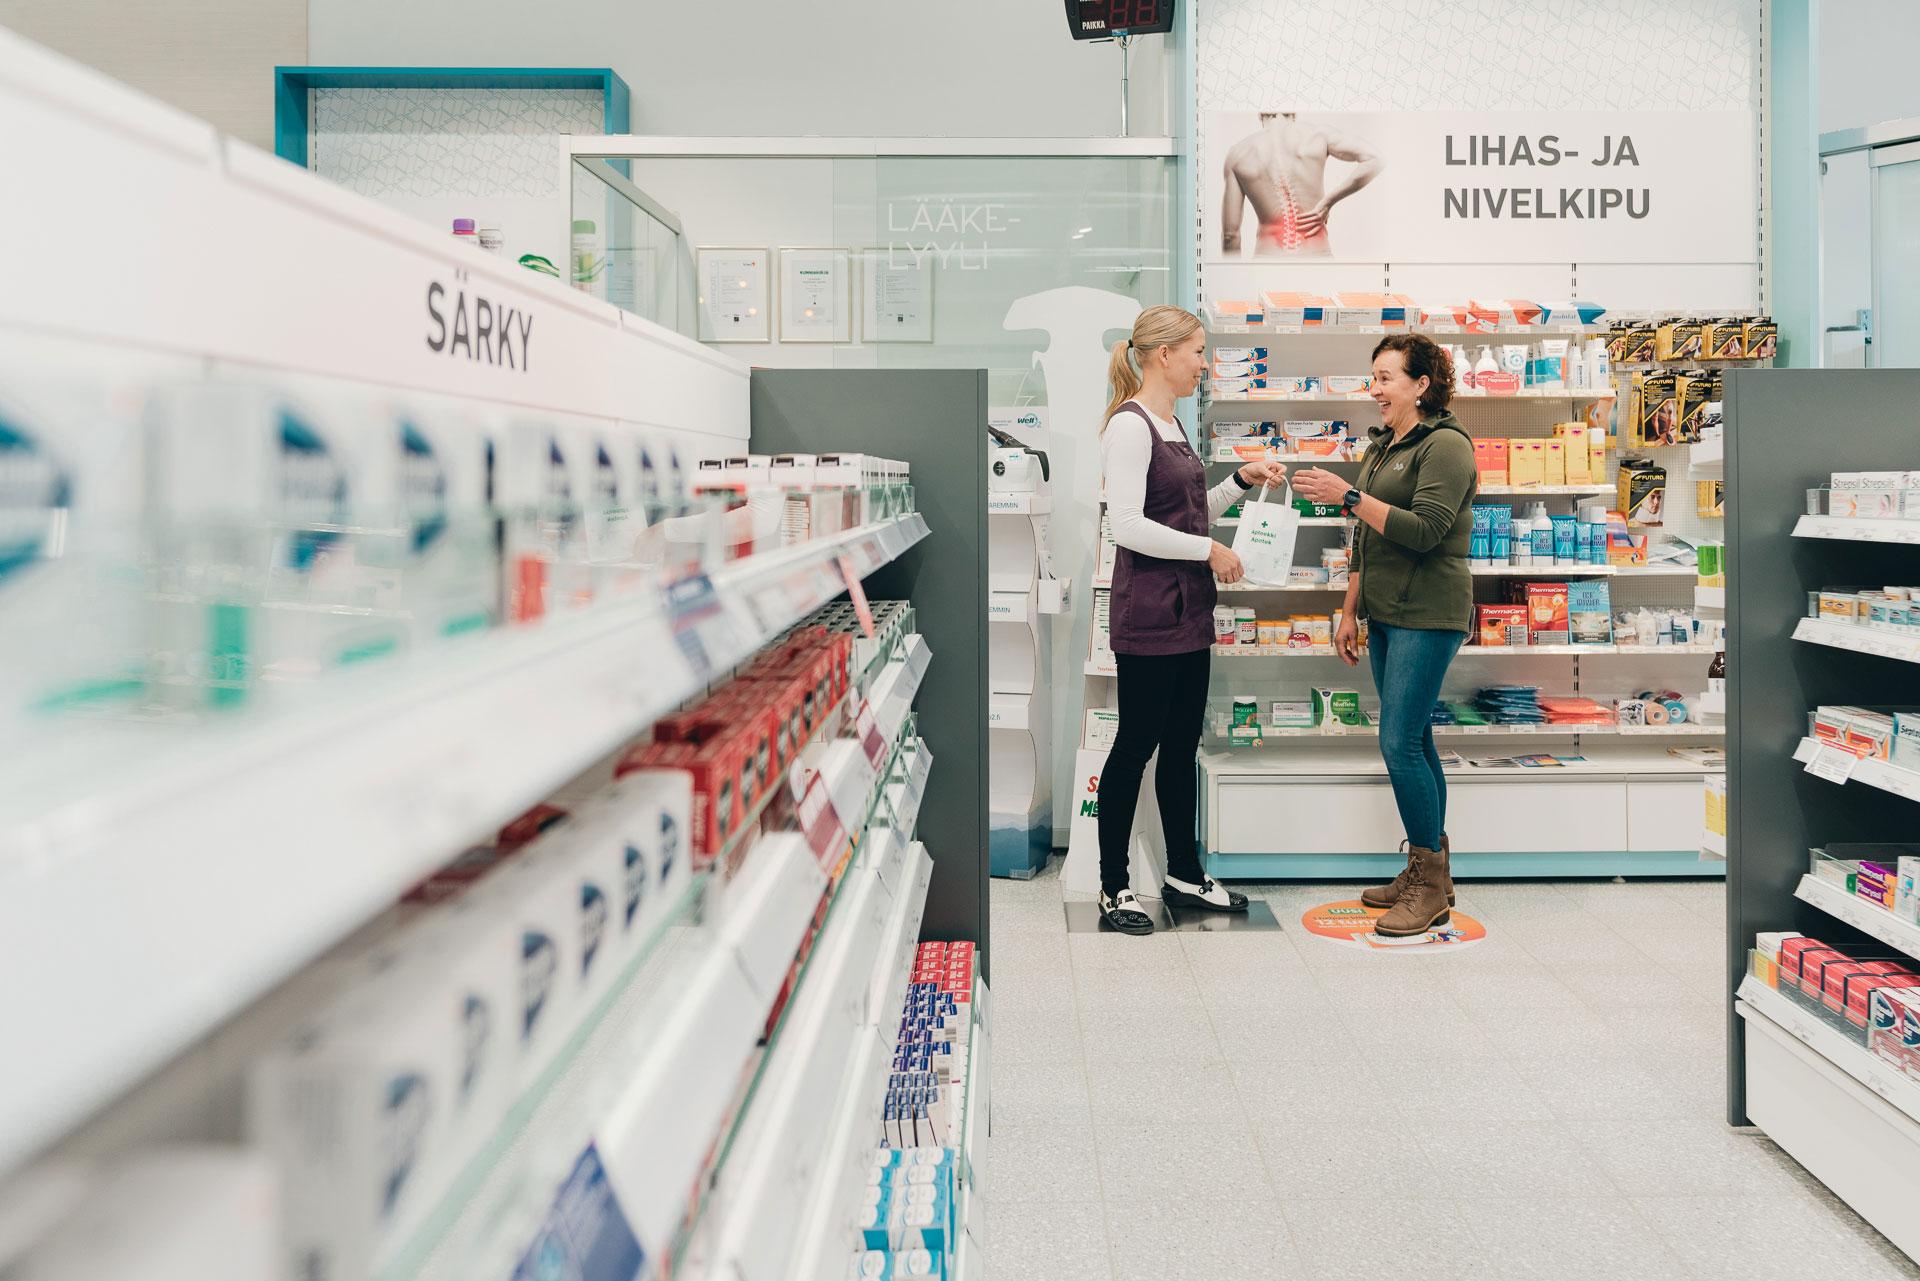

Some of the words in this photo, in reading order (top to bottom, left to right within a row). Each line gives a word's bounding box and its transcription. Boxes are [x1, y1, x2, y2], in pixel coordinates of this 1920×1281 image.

[1082, 20, 1106, 31] PAIKKA
[1445, 135, 1579, 167] LIHAS-
[1591, 135, 1640, 167] JA
[889, 198, 1021, 234] LÄÄKE-
[1444, 188, 1650, 219] NIVELKIPU
[889, 240, 988, 270] LYYLI
[426, 266, 533, 372] SÄRKY
[1314, 506, 1326, 516] 50
